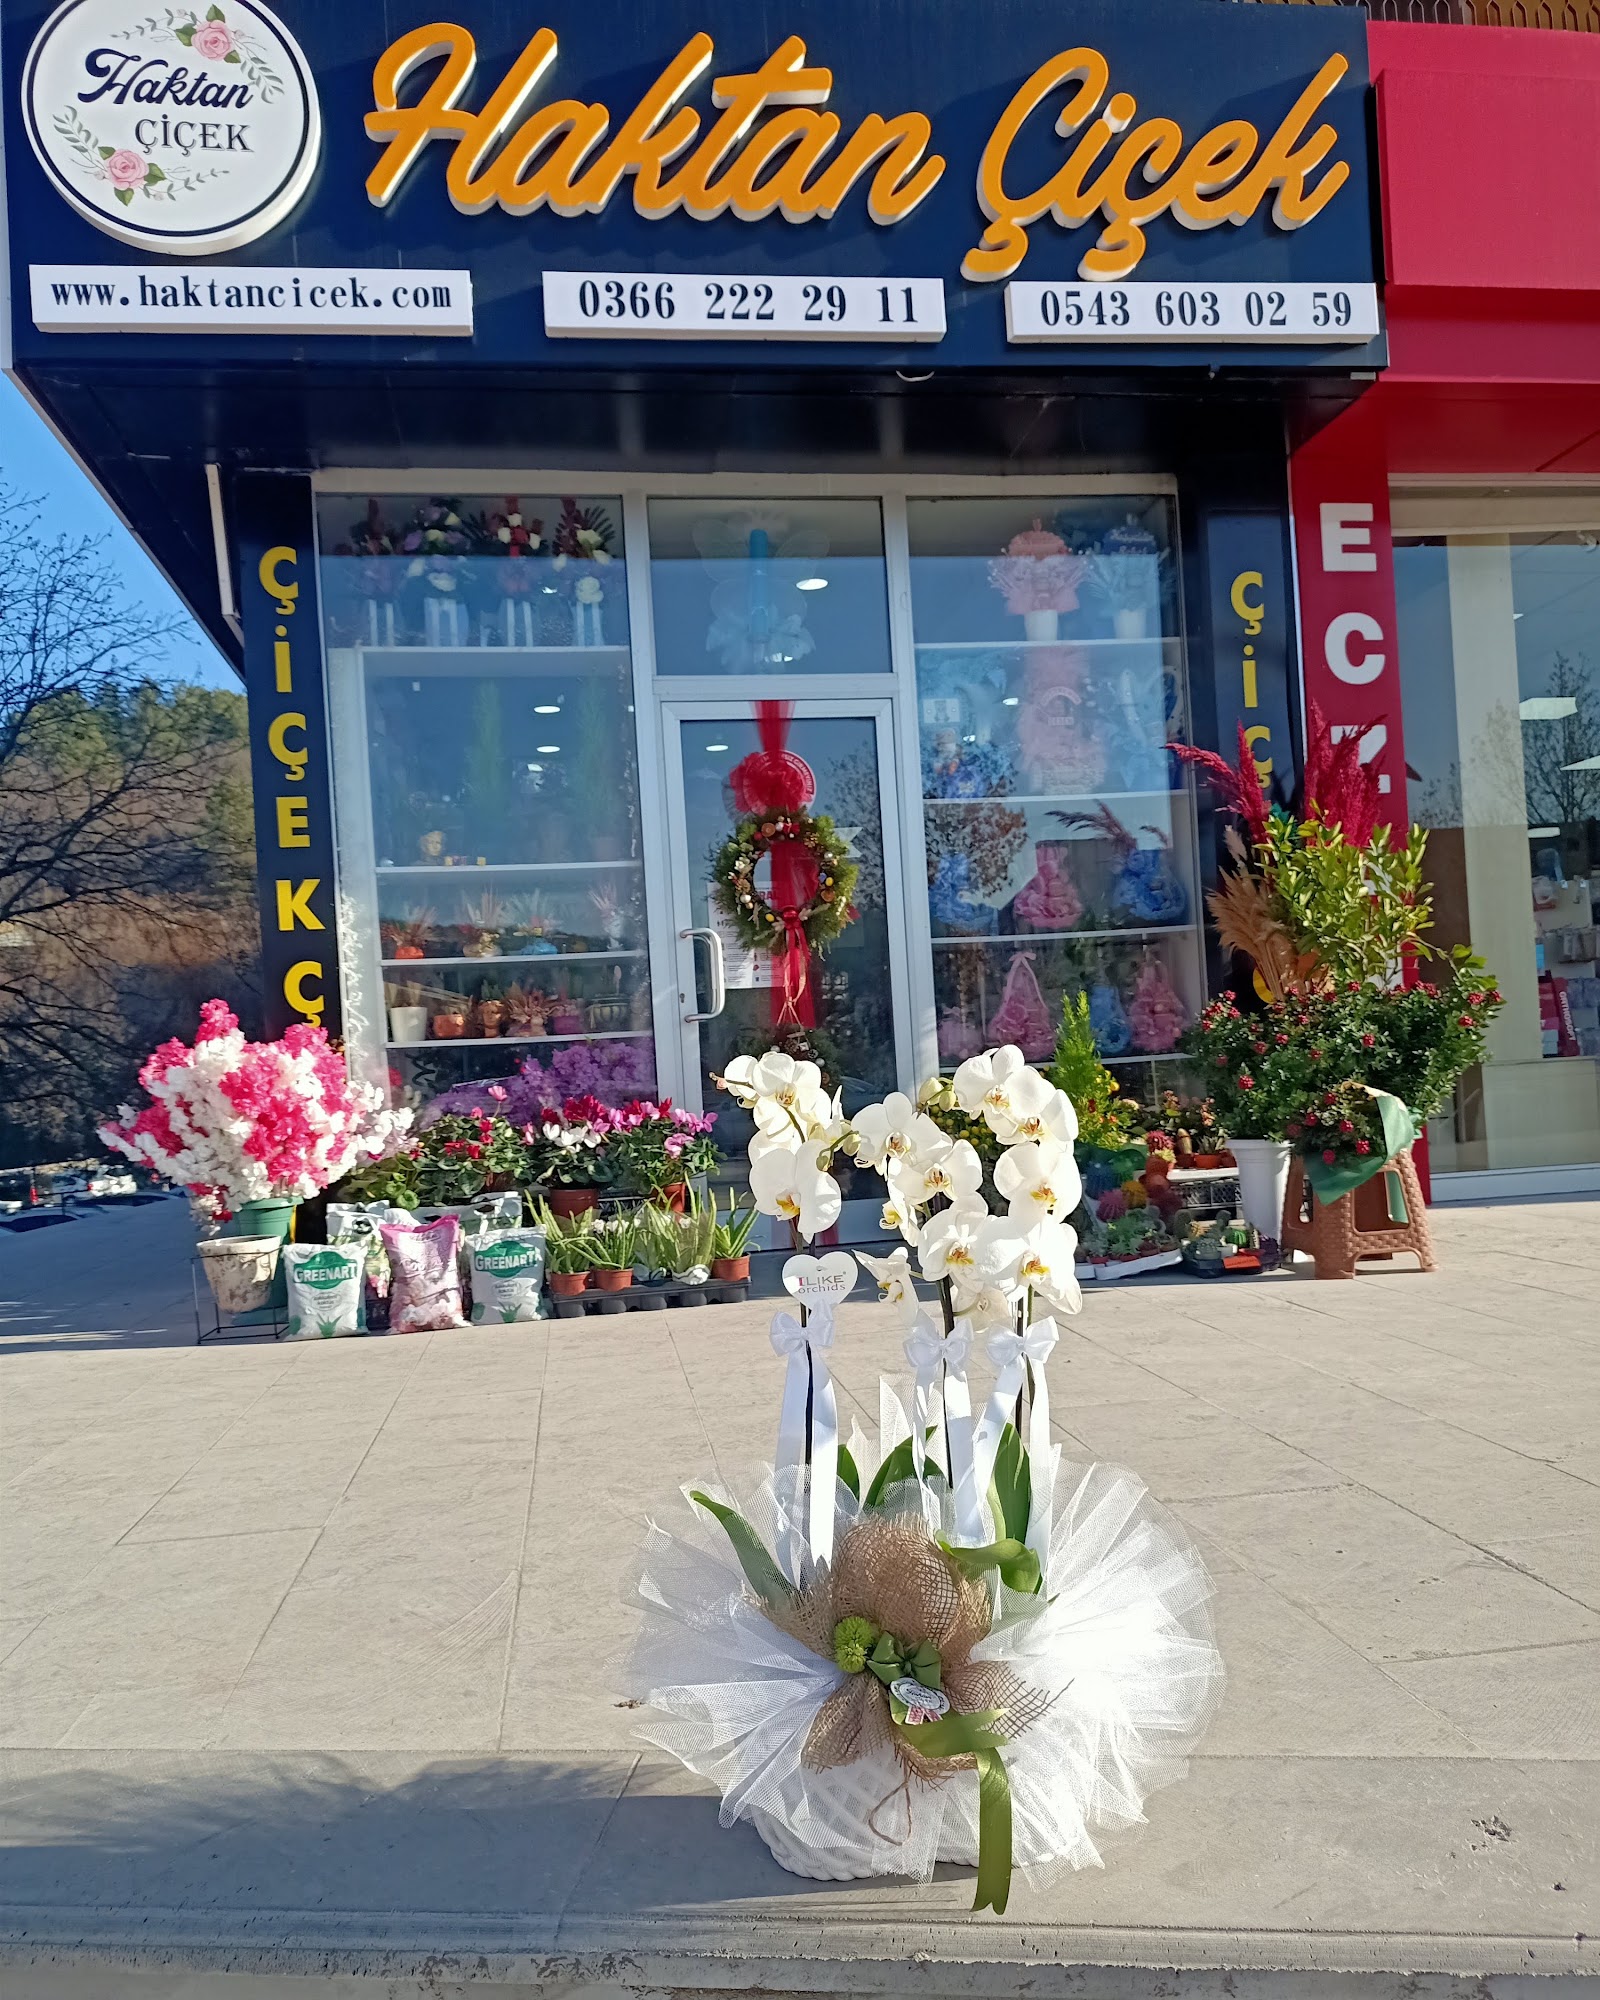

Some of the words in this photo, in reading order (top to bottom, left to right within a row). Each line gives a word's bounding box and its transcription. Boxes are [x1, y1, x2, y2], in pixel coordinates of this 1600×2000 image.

[78, 48, 253, 109] Haktan
[135, 114, 253, 156] ÇİÇEK
[364, 23, 947, 224] Haktan
[961, 48, 1350, 279] Çiçek
[51, 275, 452, 309] www.haktancicek.com
[579, 281, 676, 319] 0366
[704, 283, 776, 321] 222
[802, 284, 847, 321] 29
[877, 286, 917, 323] 11
[1041, 290, 1130, 326] 0543
[1155, 292, 1220, 326] 603
[1245, 292, 1287, 327] 02
[1312, 292, 1352, 327] 59
[293, 1262, 358, 1283] GREENART
[475, 1250, 536, 1271] GREENART
[798, 1283, 846, 1294] orchids
